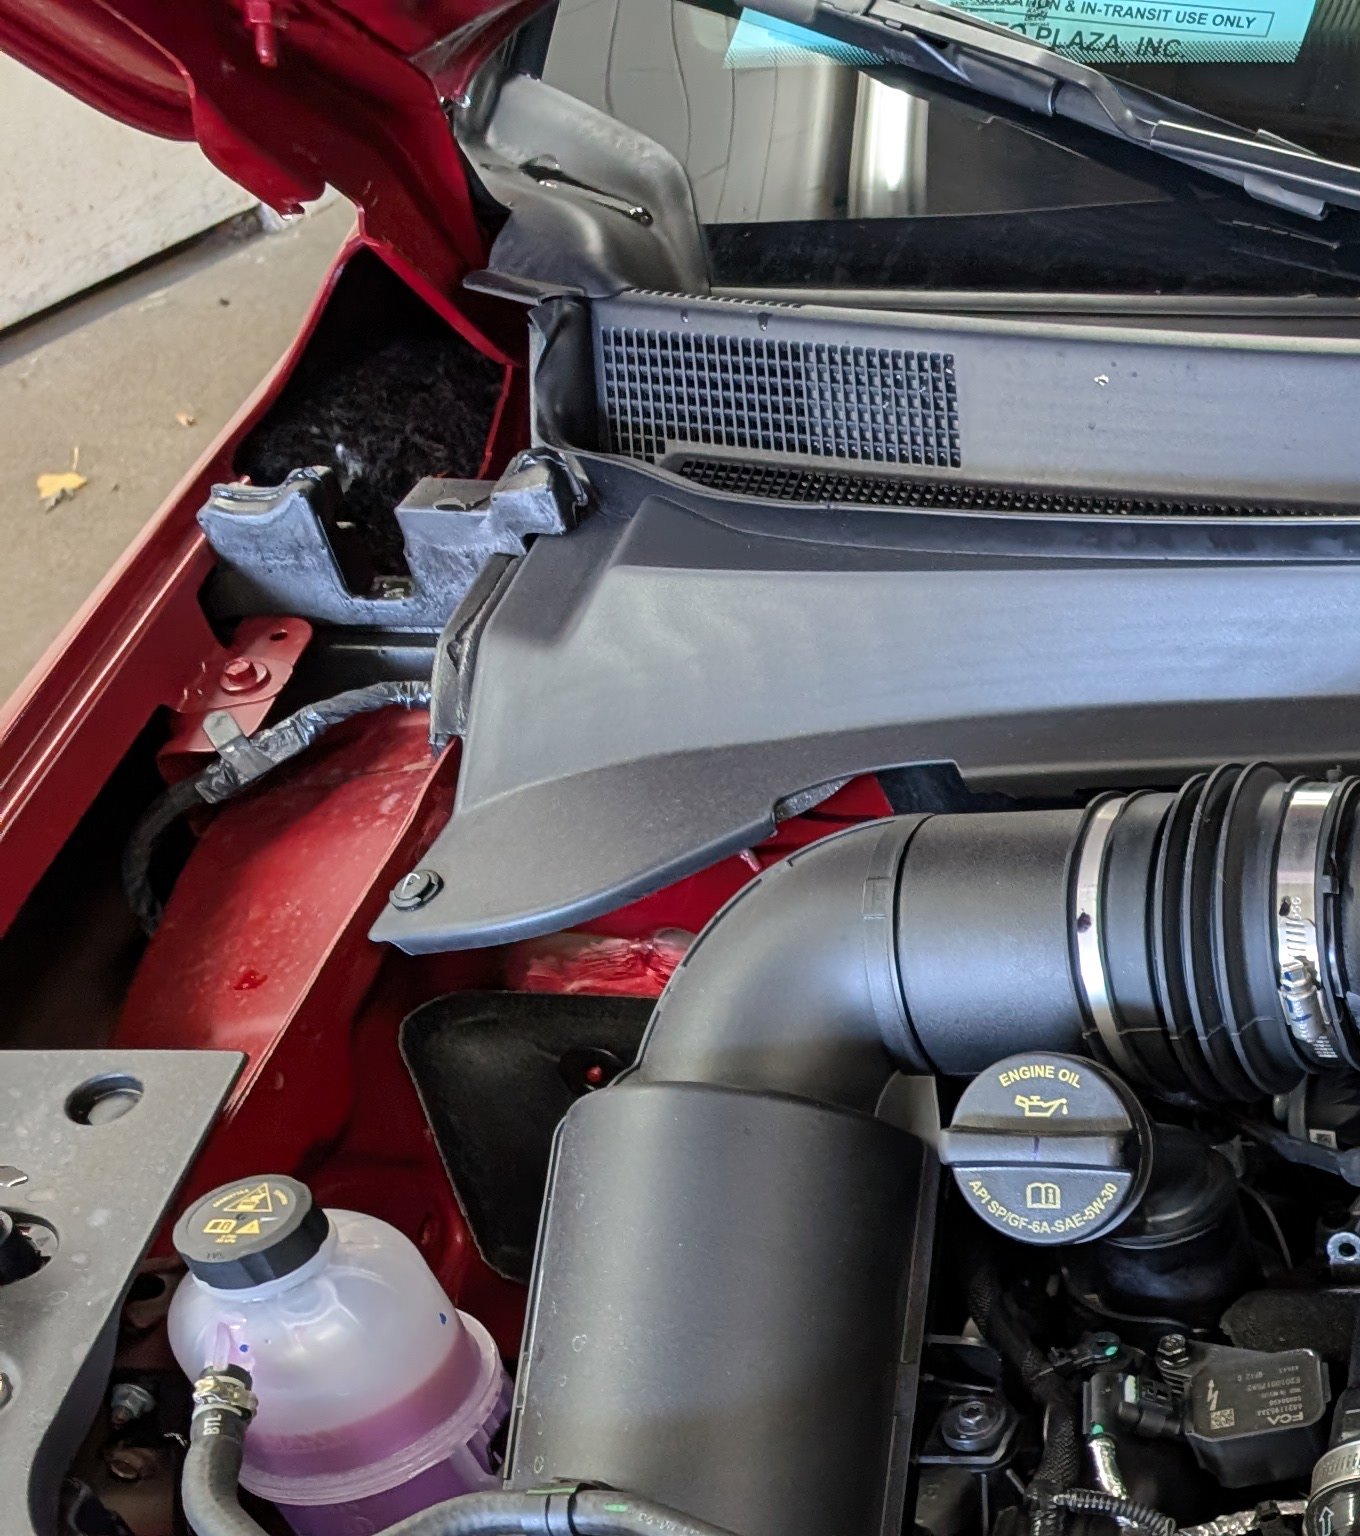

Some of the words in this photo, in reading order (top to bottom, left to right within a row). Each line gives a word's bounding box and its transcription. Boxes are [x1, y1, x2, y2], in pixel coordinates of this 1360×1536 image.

[1064, 1, 1076, 13] &
[1080, 2, 1172, 22] IN-TRANSIT
[1175, 11, 1208, 26] USE
[1212, 14, 1256, 29] ONLY
[998, 1065, 1055, 1087] ENGINE
[1058, 1068, 1081, 1088] OIL
[968, 1181, 991, 1204] API
[987, 1182, 1118, 1234] SP/GF-6A-SAE-5W-30
[1267, 1411, 1304, 1425] FCA
